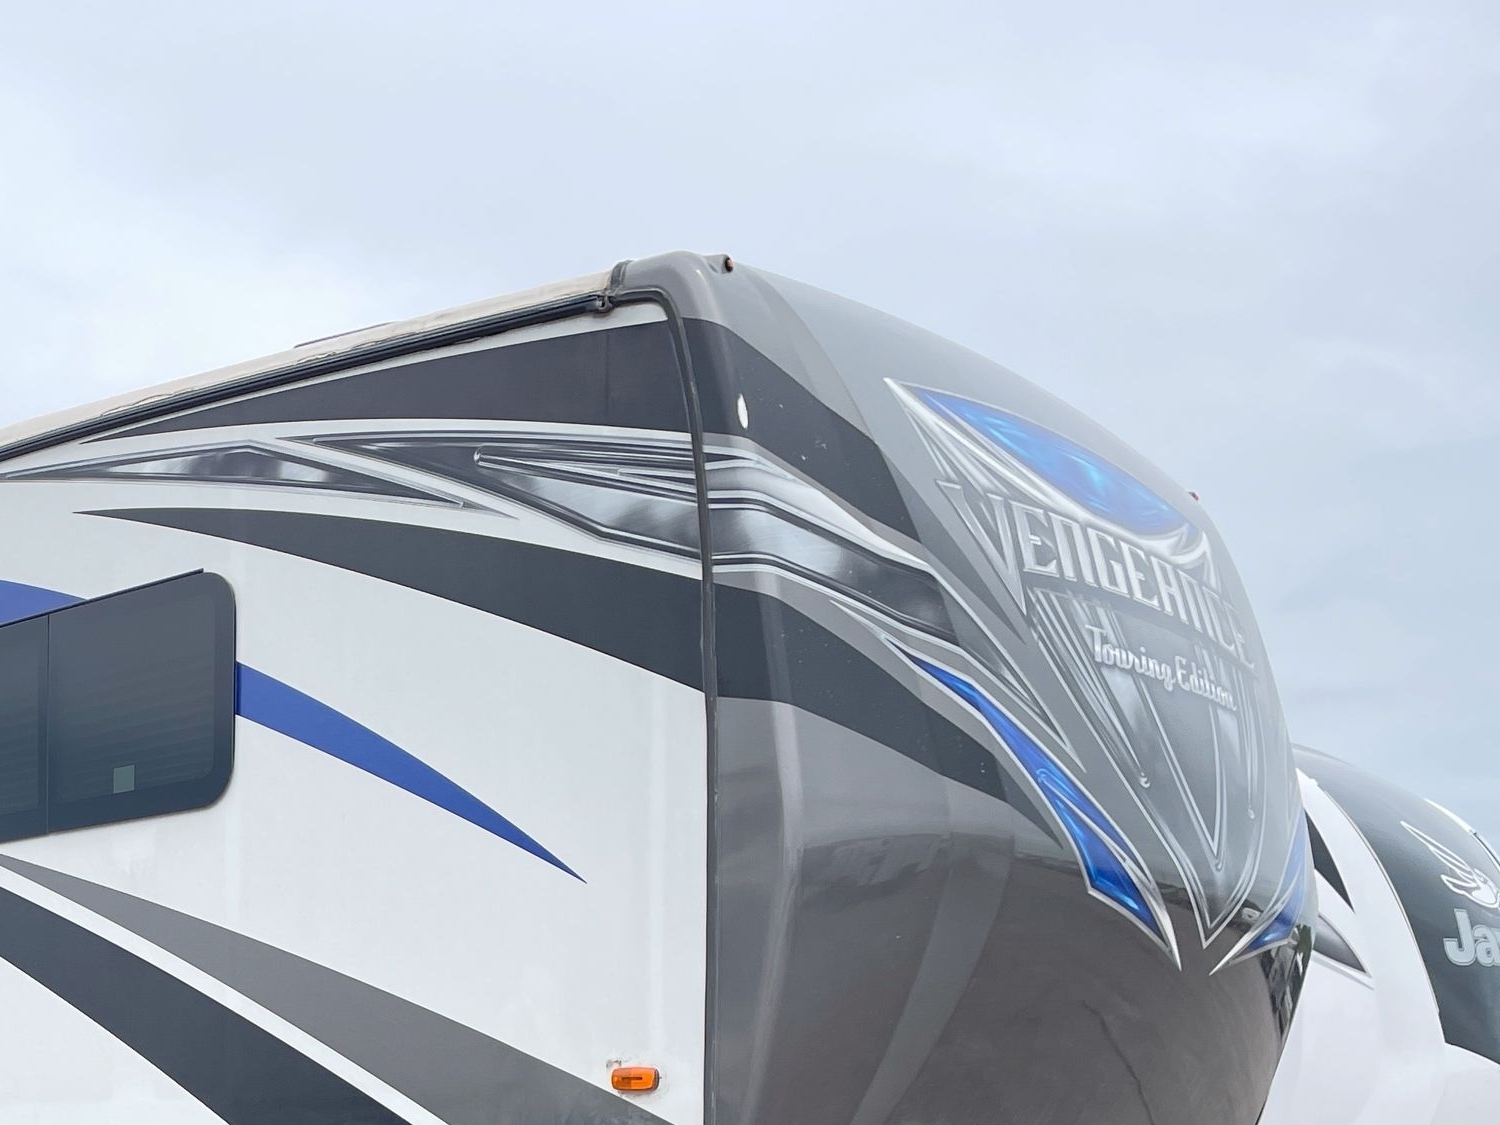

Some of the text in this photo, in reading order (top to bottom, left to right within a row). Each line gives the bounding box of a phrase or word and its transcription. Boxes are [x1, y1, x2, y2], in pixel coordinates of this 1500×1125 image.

[934, 478, 1255, 669] VENGEANCE
[1085, 625, 1238, 711] Touring Edition
